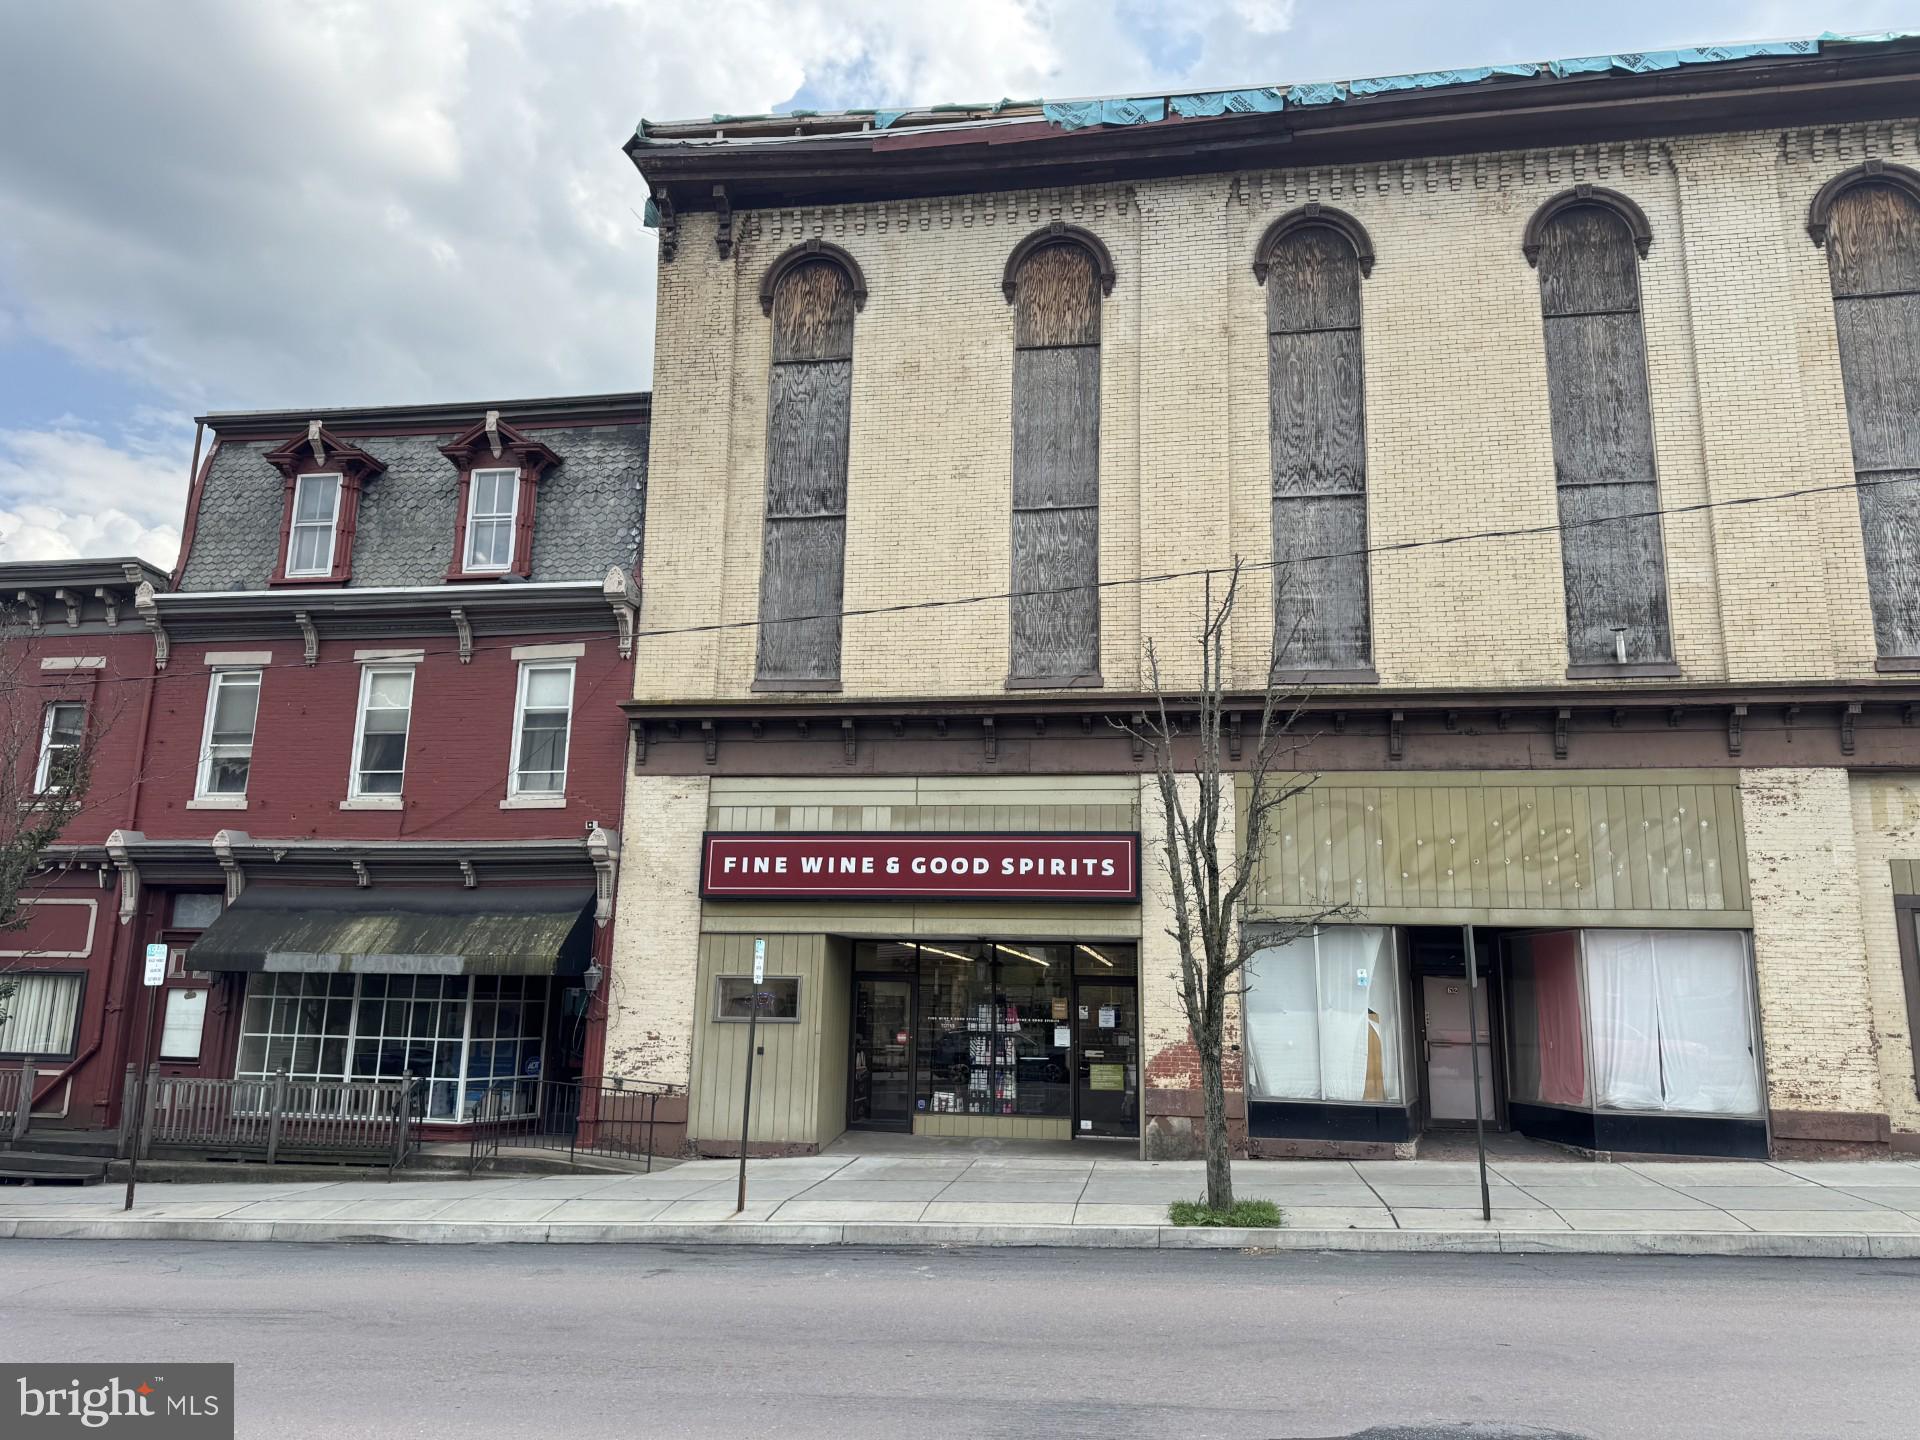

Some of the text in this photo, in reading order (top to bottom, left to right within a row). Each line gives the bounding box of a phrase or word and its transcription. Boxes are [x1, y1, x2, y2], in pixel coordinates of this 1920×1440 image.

[723, 856, 1116, 876] FINE WINE & GOOD SPIRITS
